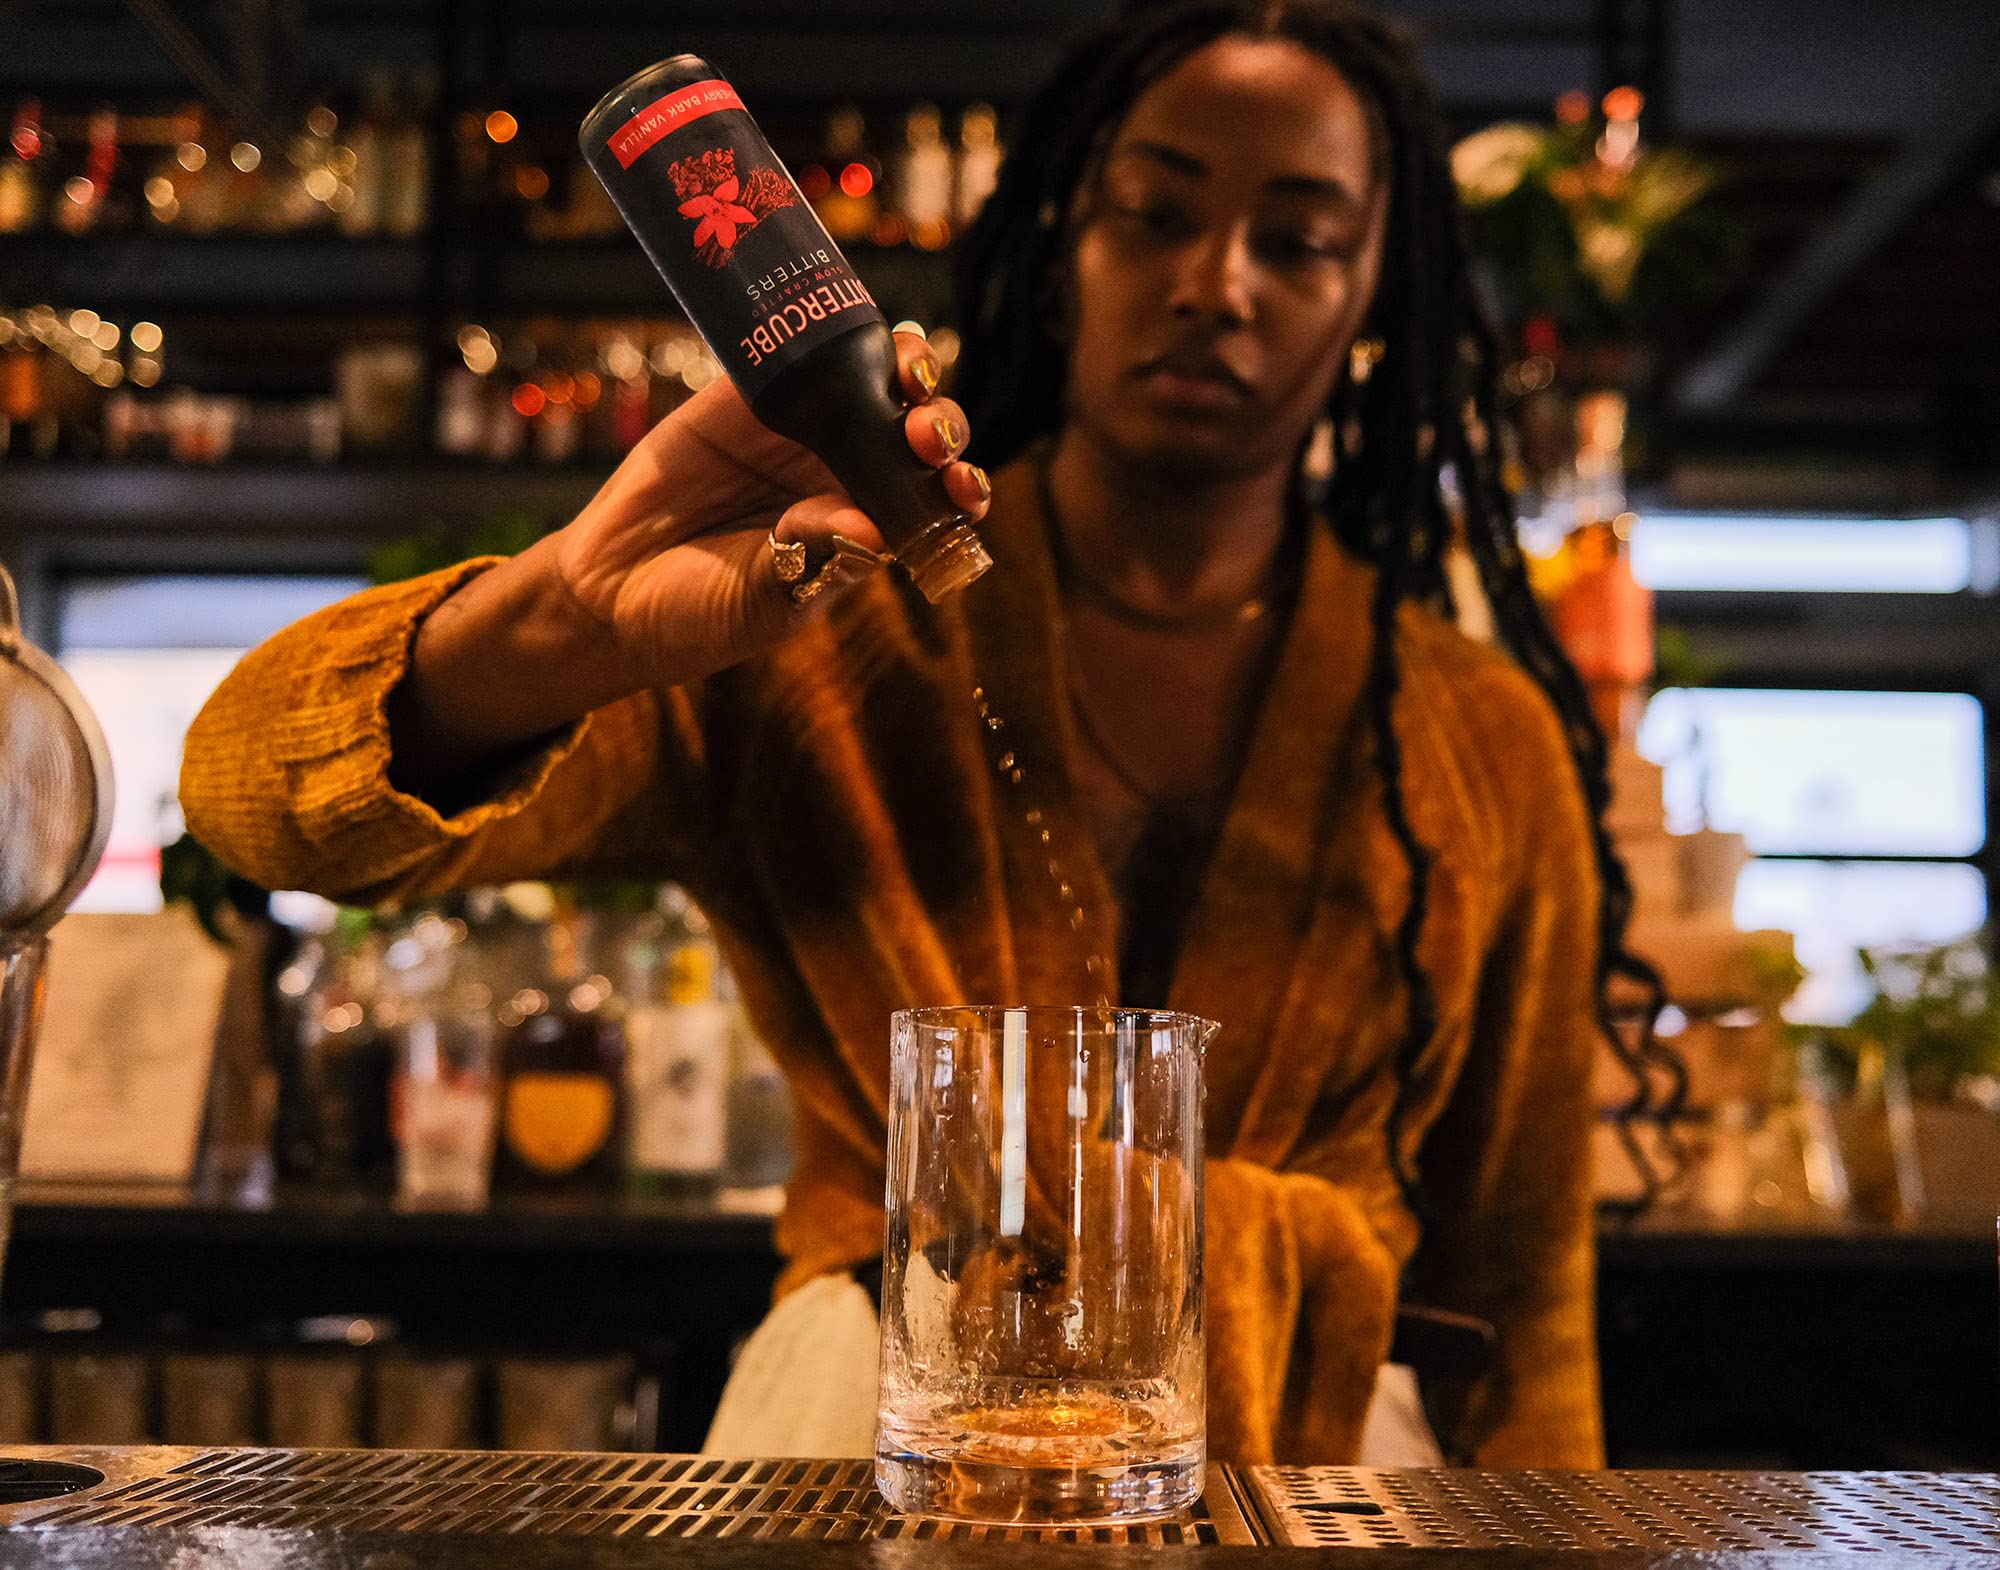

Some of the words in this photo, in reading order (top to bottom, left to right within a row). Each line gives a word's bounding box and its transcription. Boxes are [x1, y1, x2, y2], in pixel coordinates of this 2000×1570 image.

[666, 95, 702, 119] BARK
[619, 114, 667, 153] VANILLA
[746, 249, 831, 301] BITTERS
[814, 264, 844, 282] SLOW
[751, 277, 811, 318] CRAFTED
[739, 278, 877, 367] BITTERCUBE
